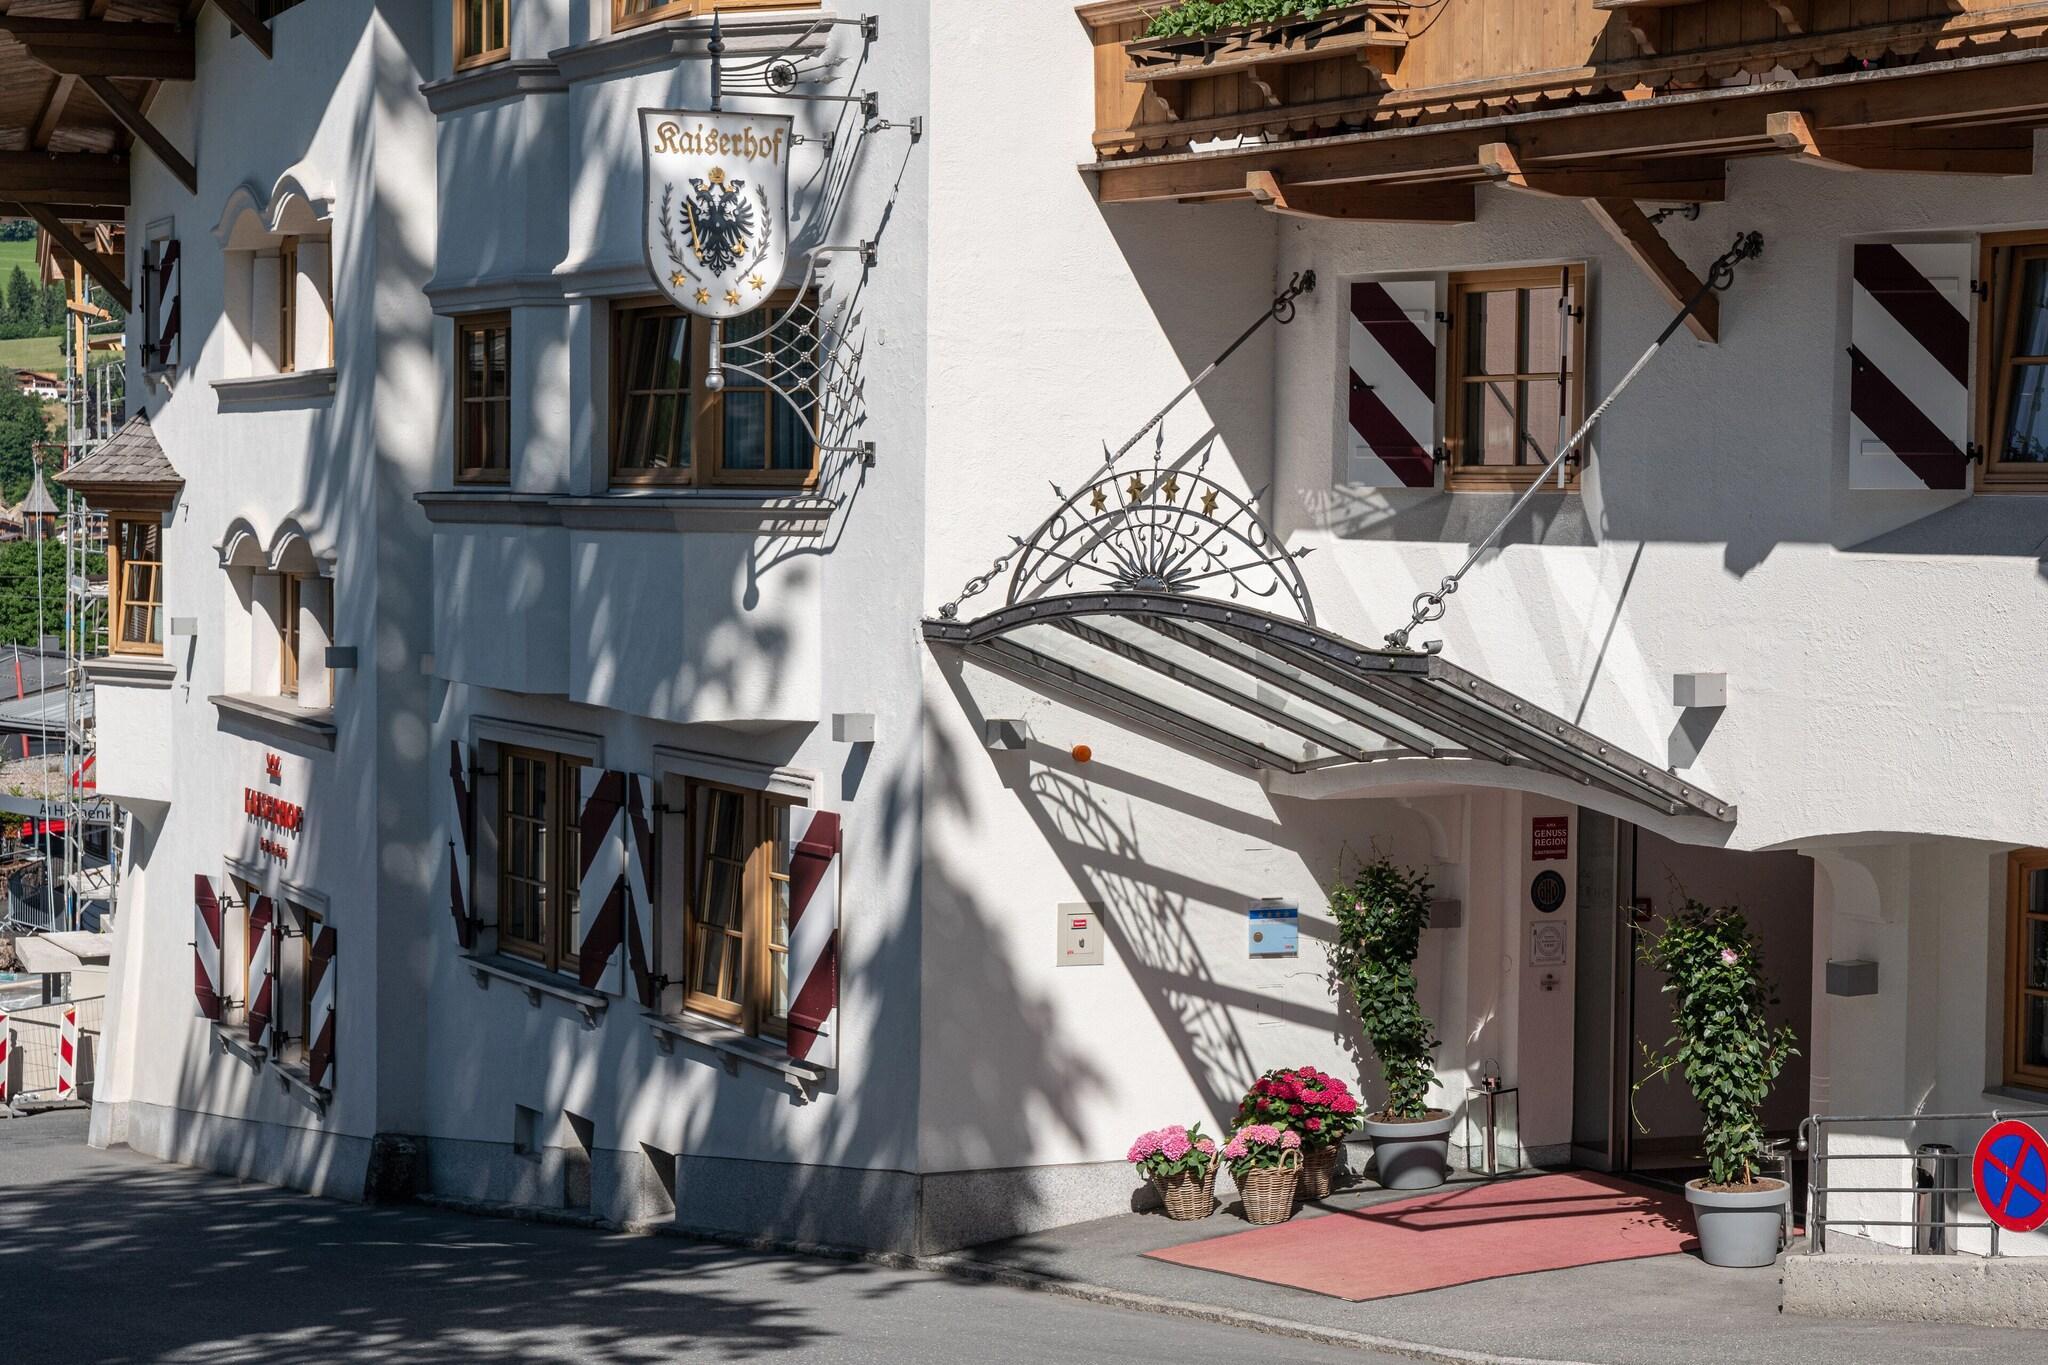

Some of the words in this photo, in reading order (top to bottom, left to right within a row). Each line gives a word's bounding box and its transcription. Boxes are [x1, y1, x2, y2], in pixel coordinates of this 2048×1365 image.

[654, 120, 784, 166] Kaiserhof
[1534, 829, 1567, 838] GENUSS
[1534, 838, 1567, 846] REGION
